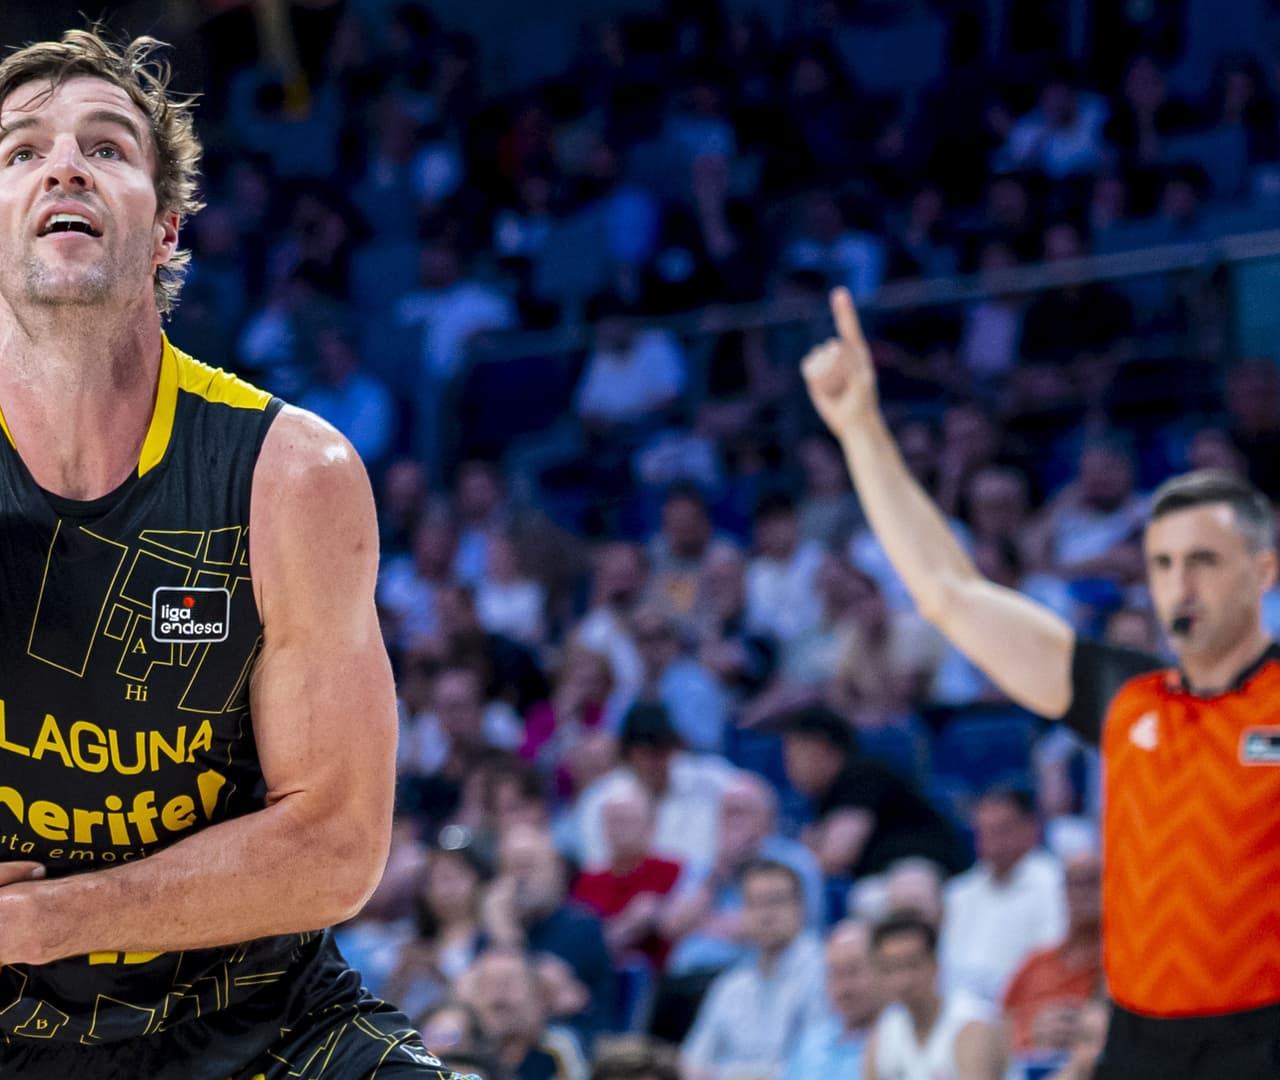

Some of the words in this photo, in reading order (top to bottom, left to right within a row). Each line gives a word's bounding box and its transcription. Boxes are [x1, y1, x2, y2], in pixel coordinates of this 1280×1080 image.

[161, 604, 191, 622] liga
[160, 620, 223, 634] endesa
[125, 684, 148, 702] Hi
